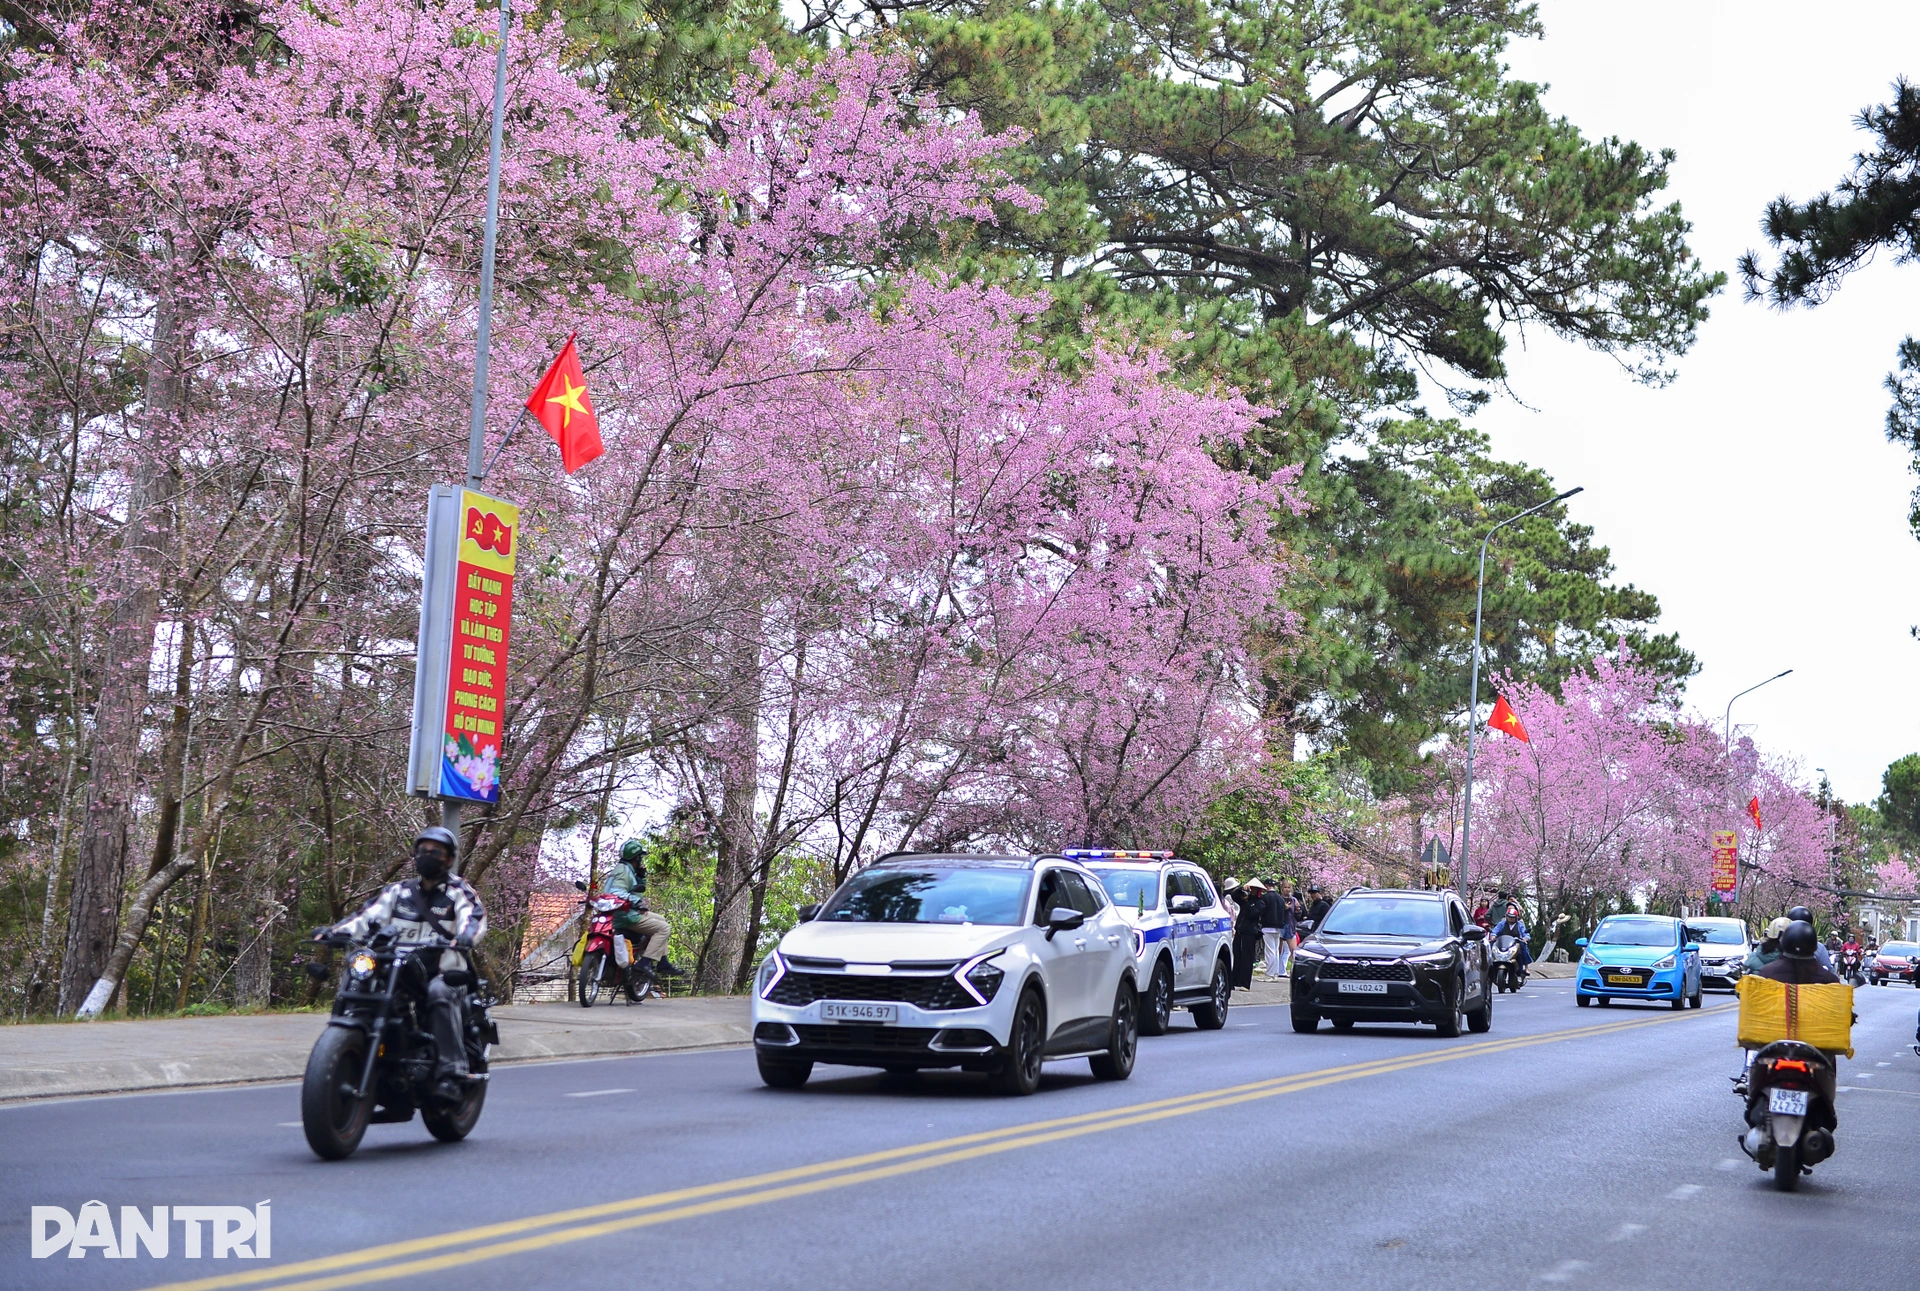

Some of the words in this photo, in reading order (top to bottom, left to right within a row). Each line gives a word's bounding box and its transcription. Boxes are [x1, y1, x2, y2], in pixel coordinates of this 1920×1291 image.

[482, 577, 502, 596] MẠNH
[486, 625, 503, 643] THEO
[453, 690, 478, 709] PHONG
[478, 693, 497, 713] CÁCH
[464, 715, 478, 732] CHÍ
[477, 718, 496, 736] MINH
[1342, 983, 1384, 992] 51L-402.42
[827, 1004, 890, 1018] 51K-946.97
